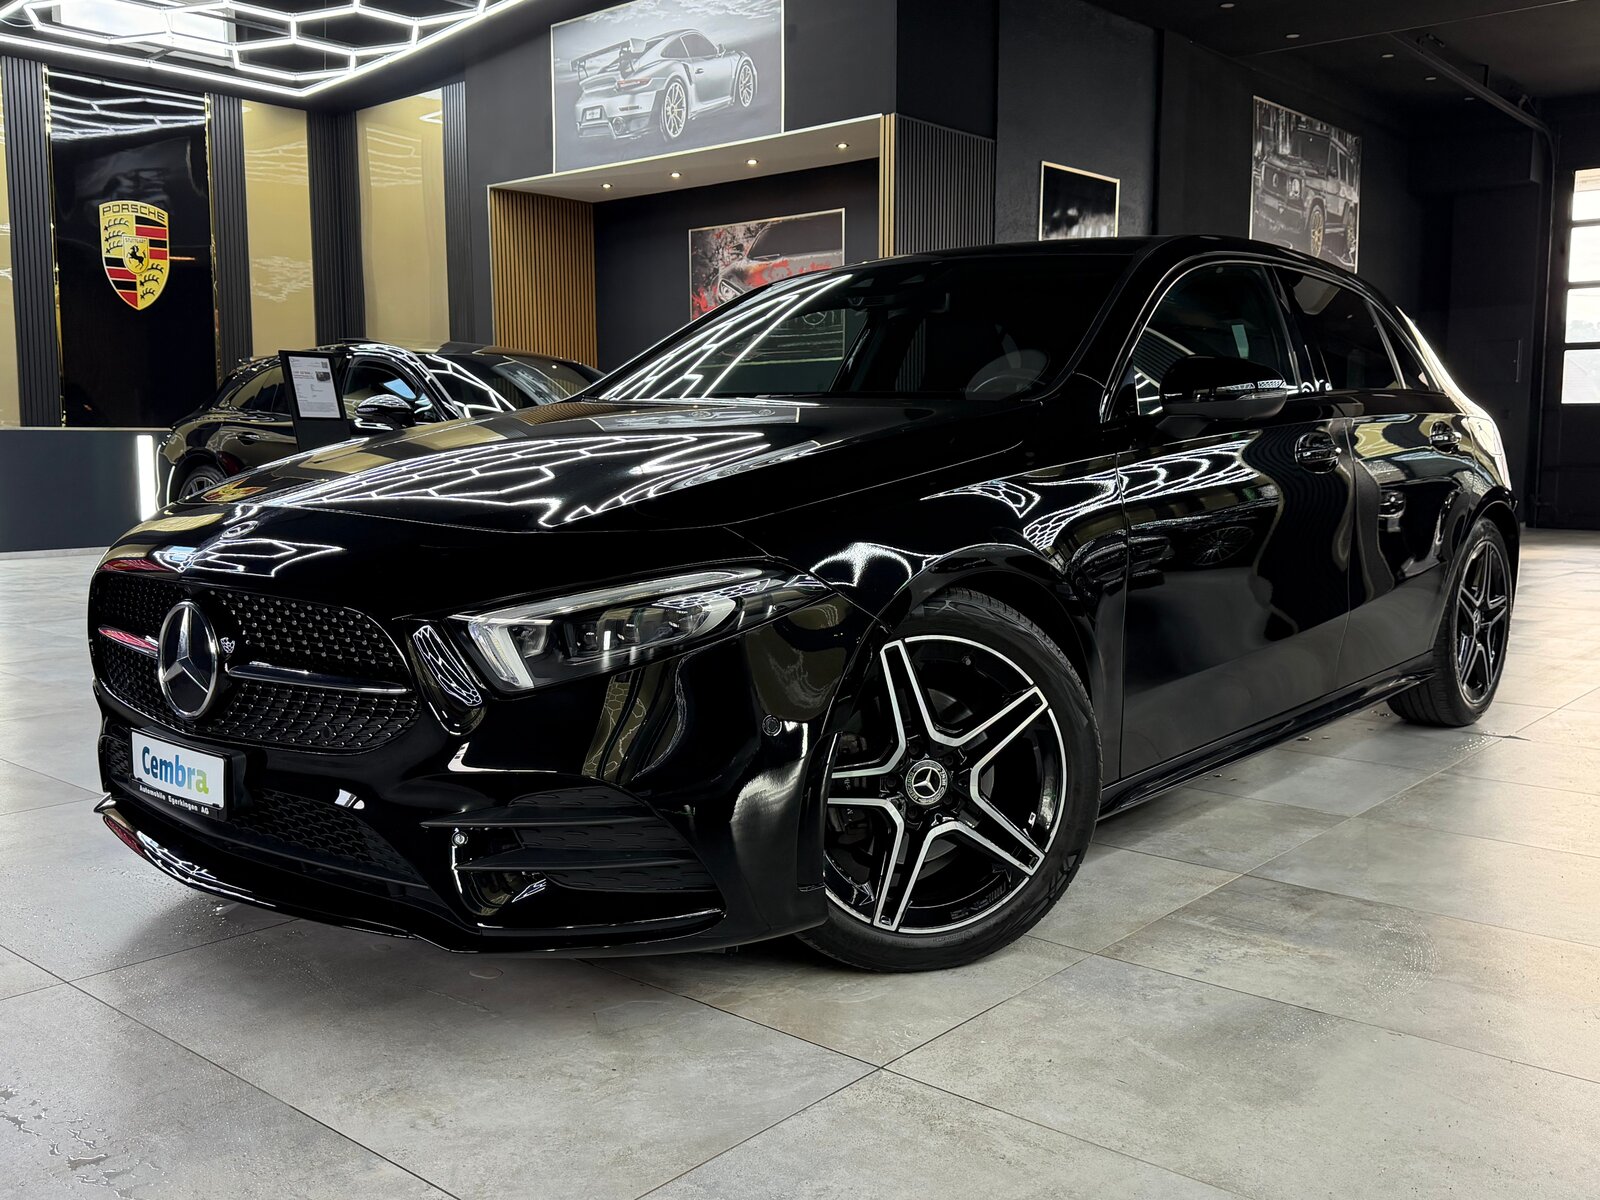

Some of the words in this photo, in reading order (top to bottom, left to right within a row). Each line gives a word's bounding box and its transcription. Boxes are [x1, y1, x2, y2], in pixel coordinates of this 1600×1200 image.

[102, 203, 166, 222] PORSCHE
[142, 746, 209, 795] Cembra
[139, 784, 166, 801] Automobile
[168, 795, 198, 812] Egerkingen
[201, 806, 210, 815] AG
